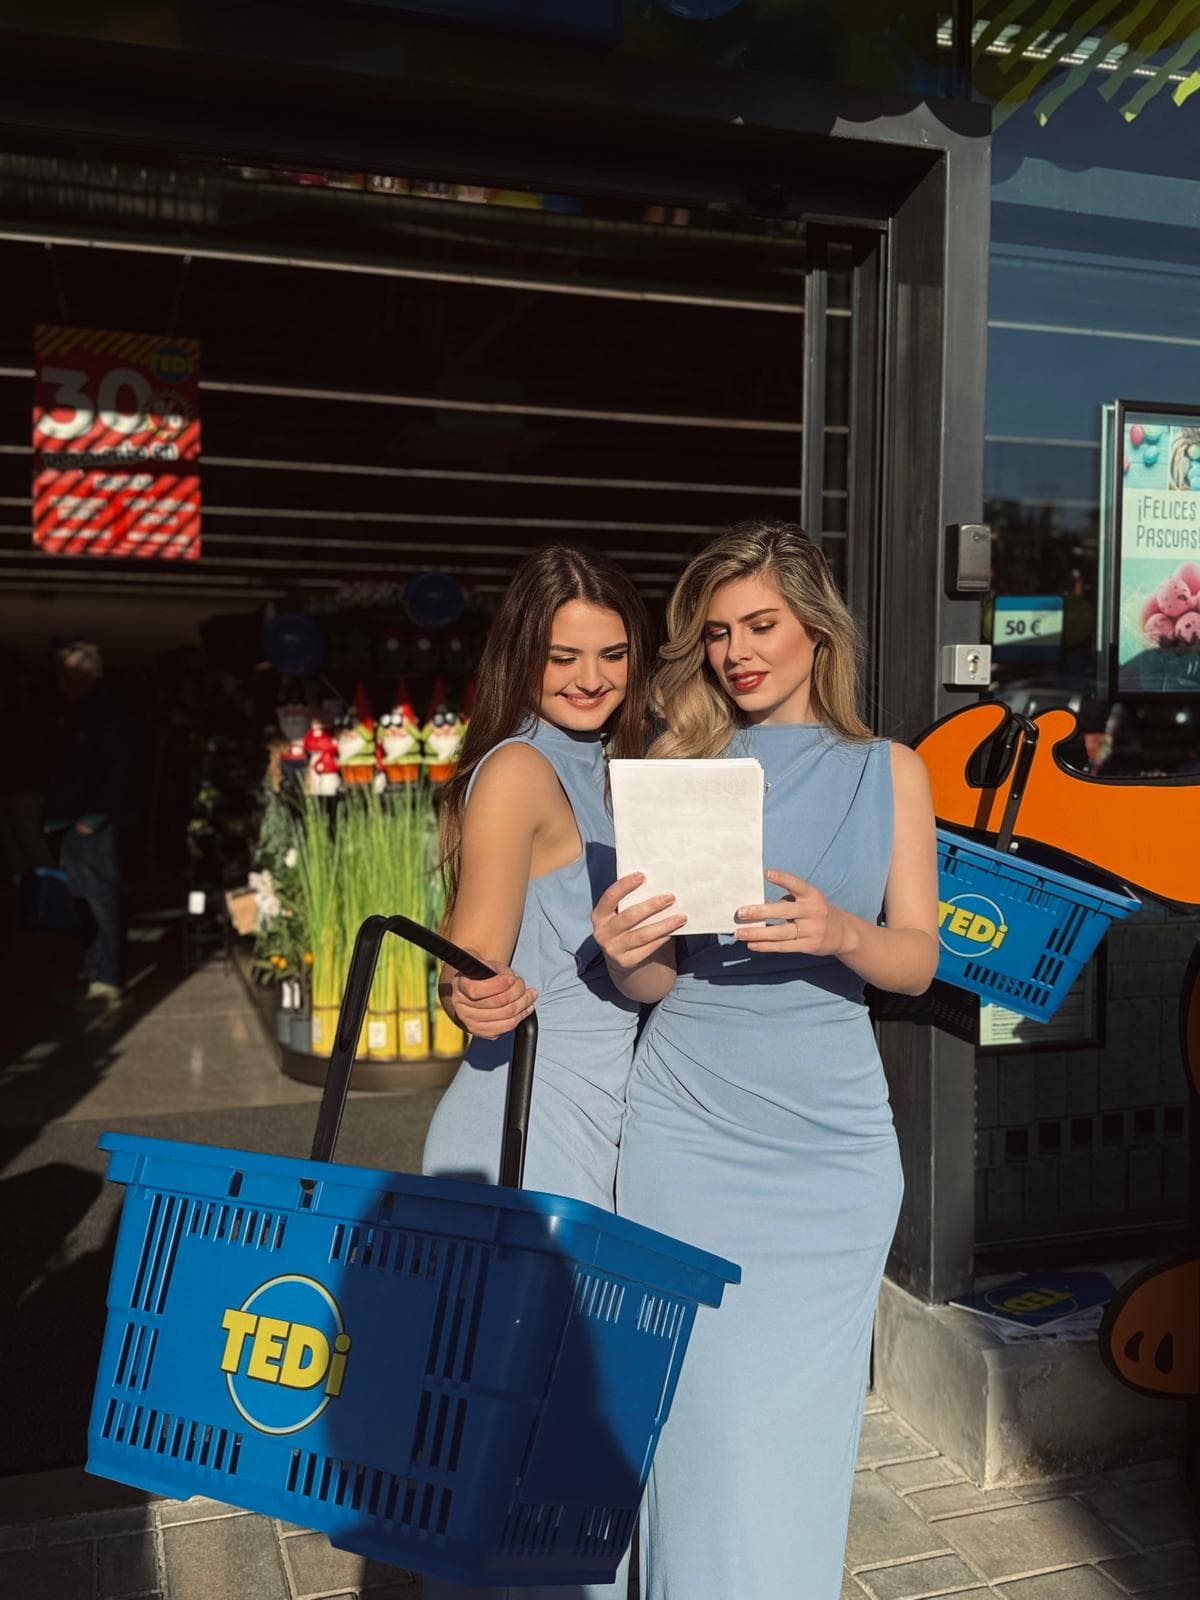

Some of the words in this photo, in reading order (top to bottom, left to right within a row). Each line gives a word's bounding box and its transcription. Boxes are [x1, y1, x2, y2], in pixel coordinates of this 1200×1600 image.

[1138, 495, 1197, 523] ¡FELICES
[1005, 620, 1026, 635] 50
[1031, 619, 1042, 635] €
[938, 900, 1008, 949] TEDi
[220, 1308, 351, 1398] TEDi
